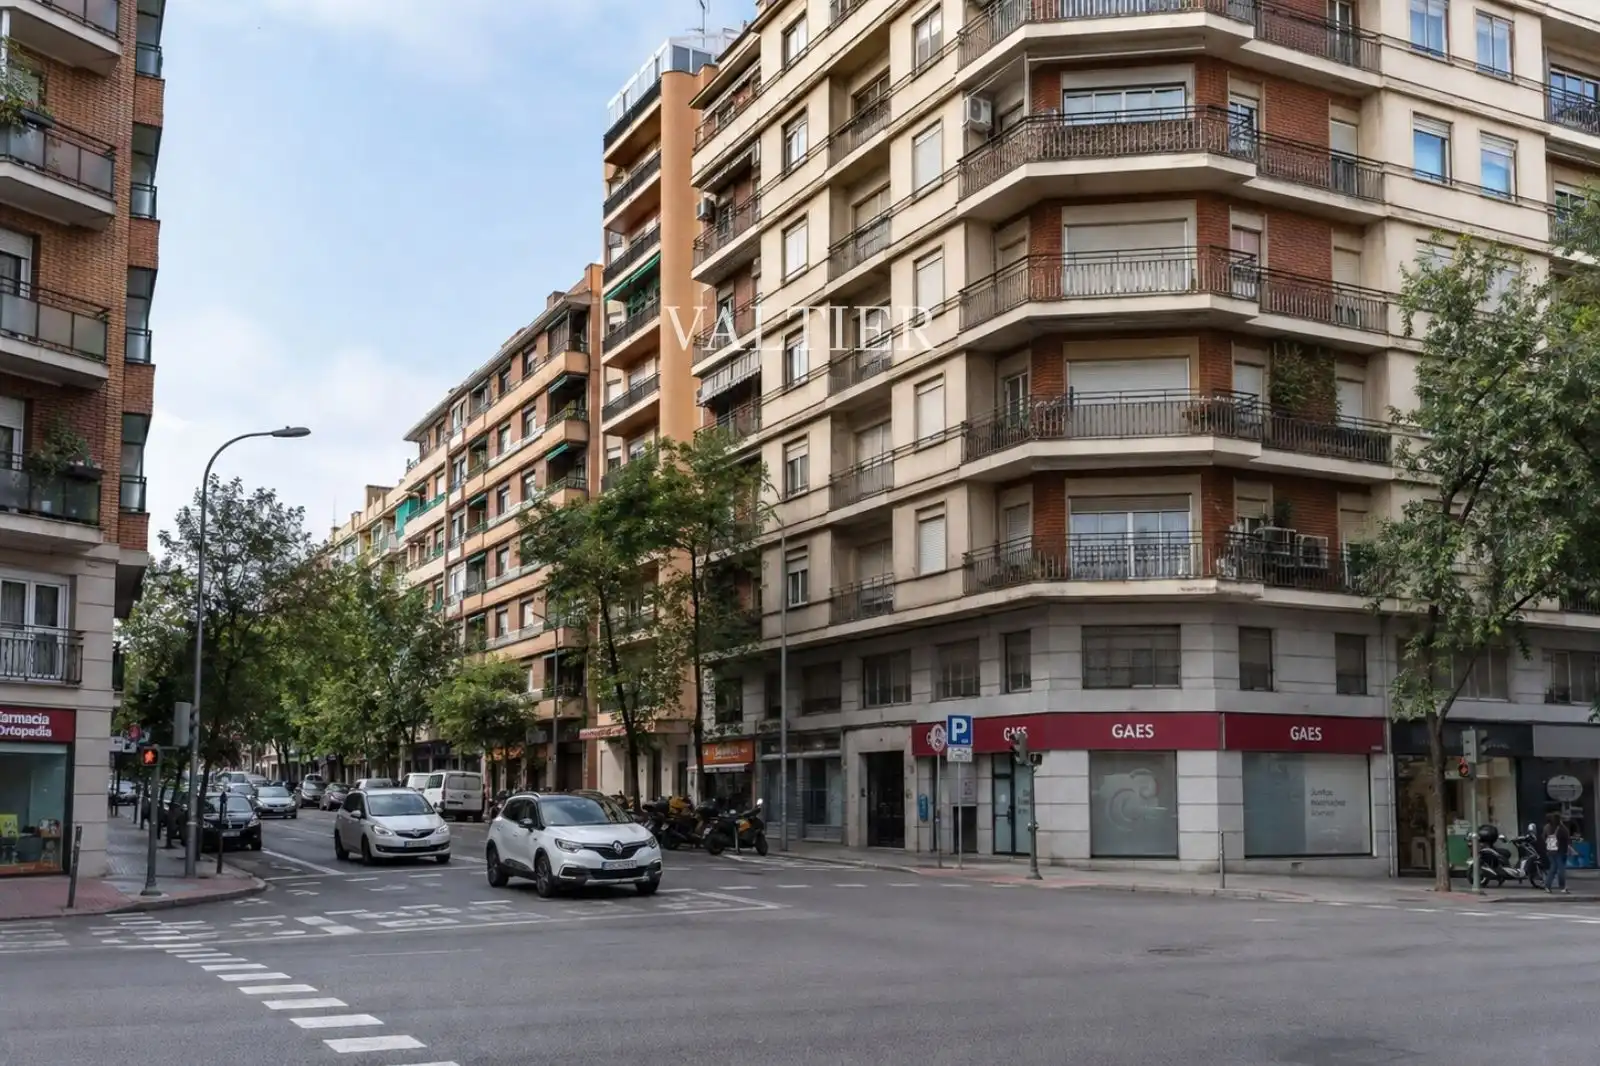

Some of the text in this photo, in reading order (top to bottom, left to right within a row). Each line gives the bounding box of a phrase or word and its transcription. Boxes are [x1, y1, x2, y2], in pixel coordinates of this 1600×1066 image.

[951, 718, 967, 741] P
[1111, 723, 1155, 739] GAES
[1290, 725, 1323, 741] GAES
